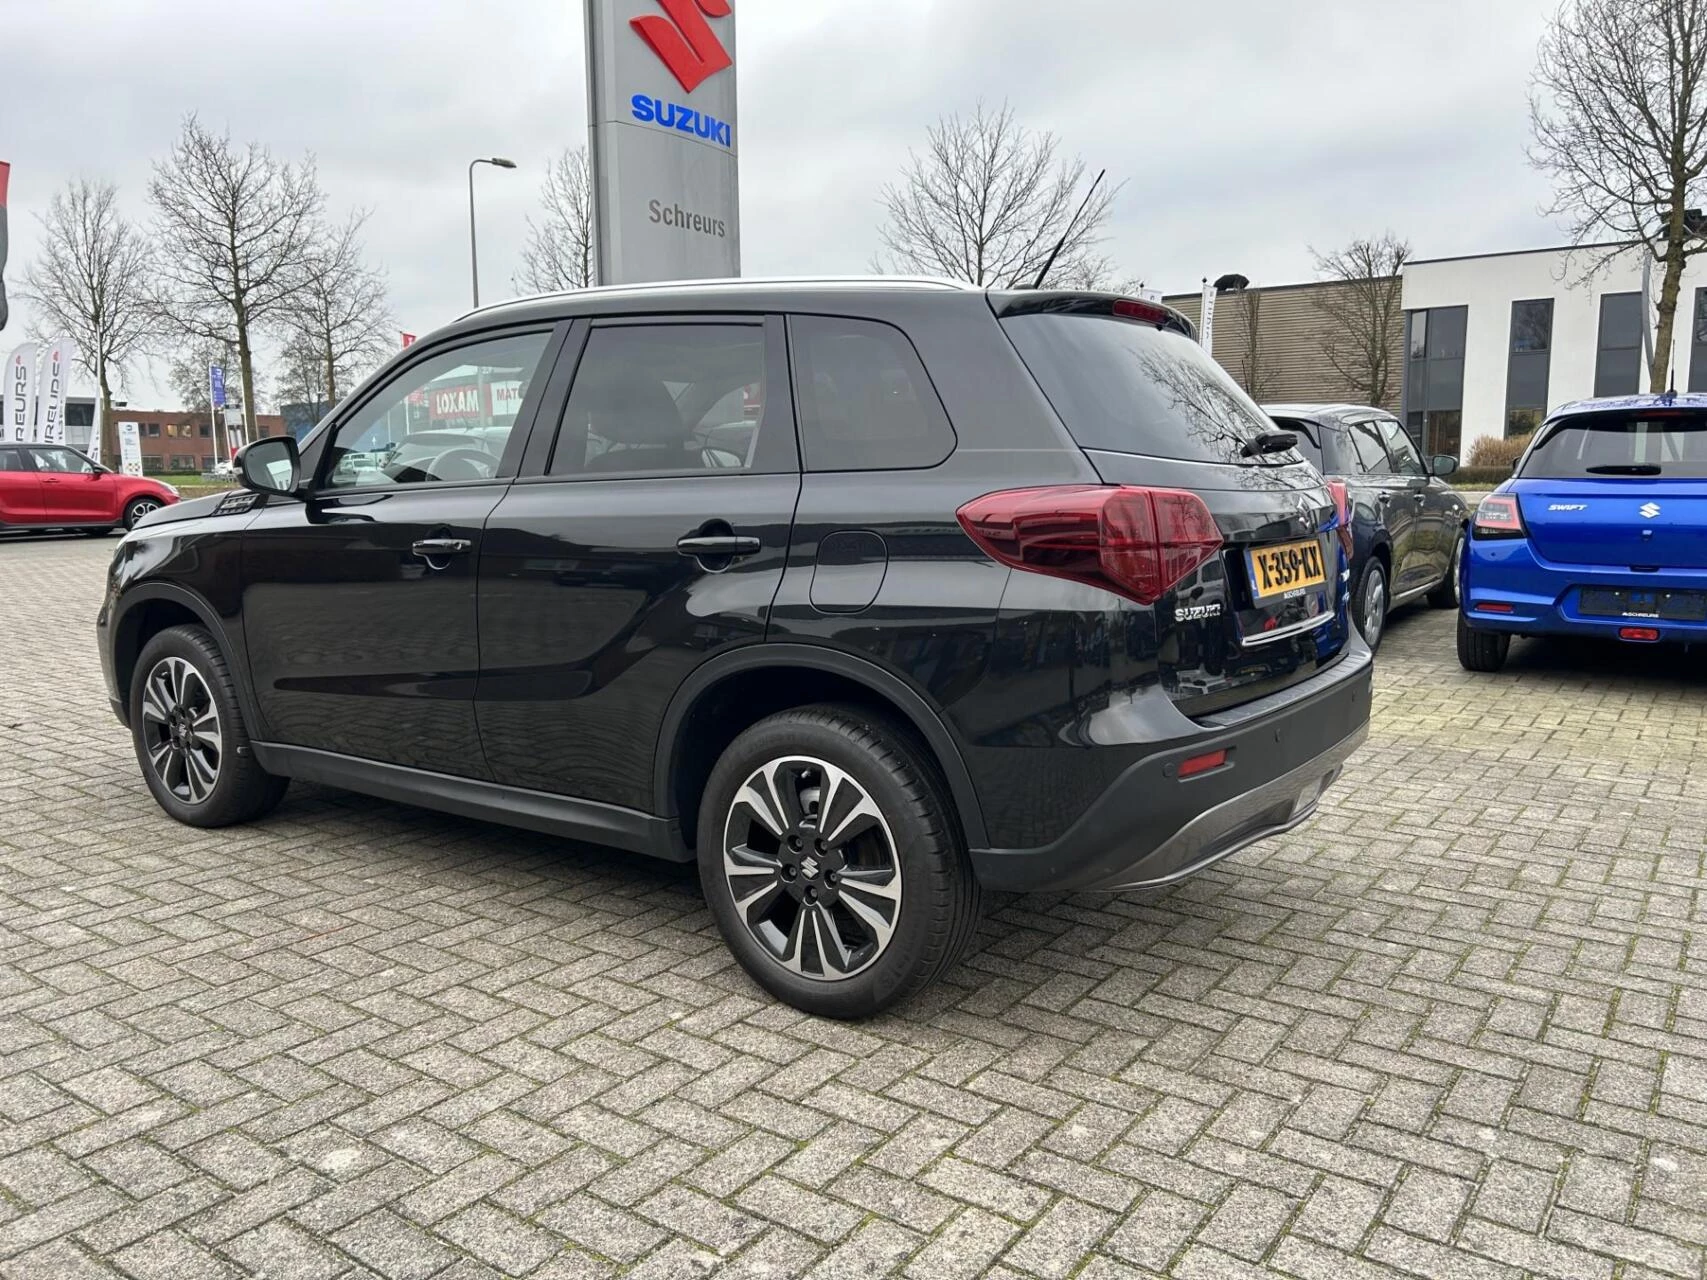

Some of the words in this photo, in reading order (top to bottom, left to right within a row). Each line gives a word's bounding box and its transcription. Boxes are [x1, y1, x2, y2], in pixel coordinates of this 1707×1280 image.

[631, 94, 731, 148] SUZUKI
[649, 199, 726, 237] Schreurs
[436, 390, 479, 414] LOXAM
[1257, 545, 1321, 590] X-359-KX
[1175, 603, 1221, 622] SUZUKI
